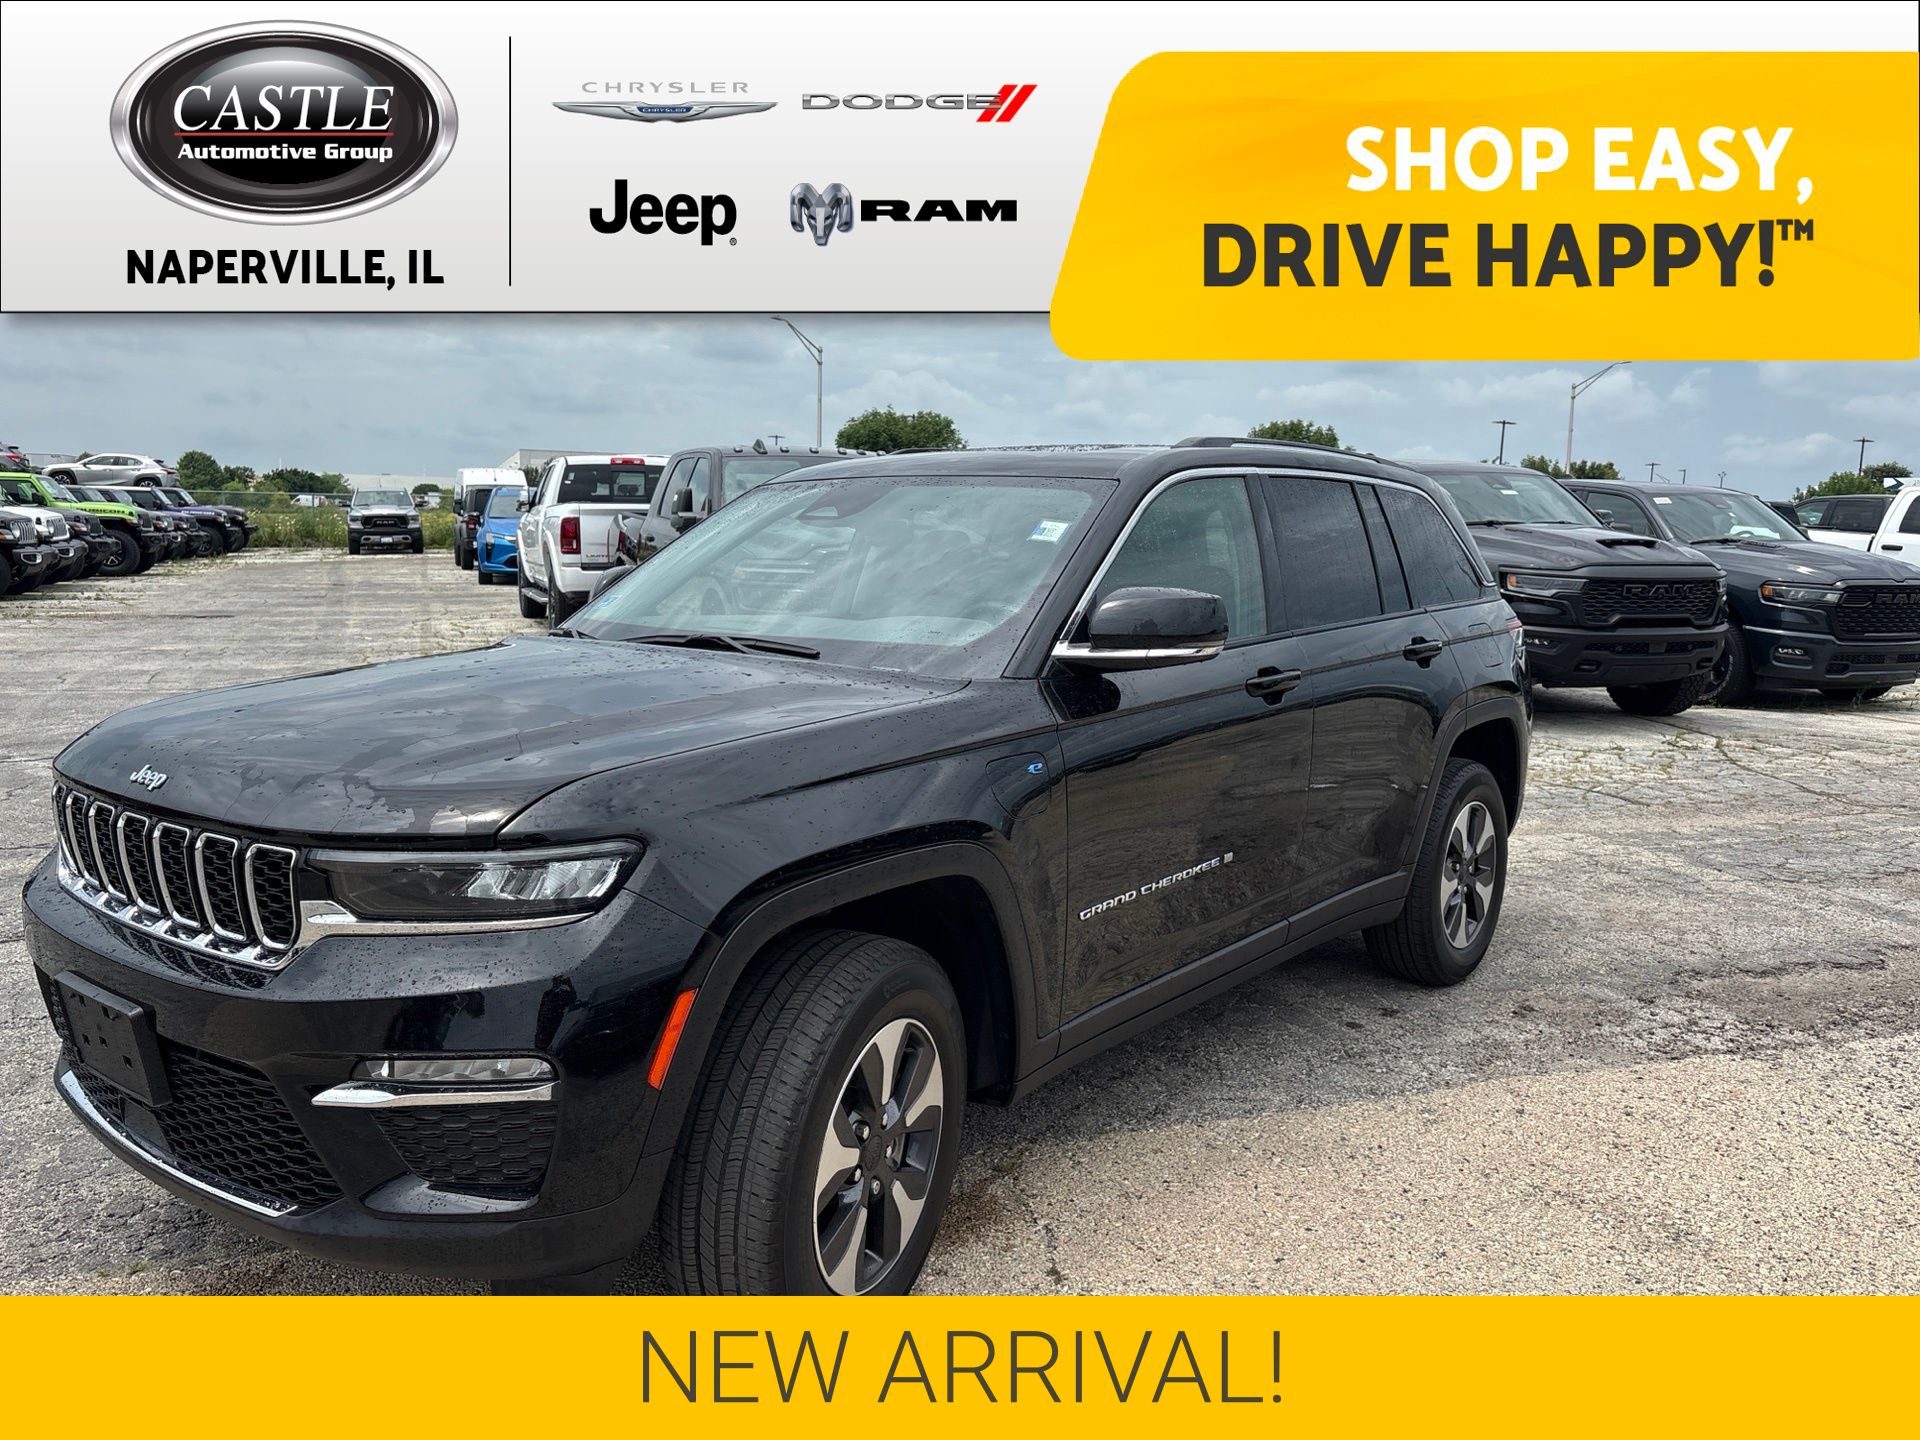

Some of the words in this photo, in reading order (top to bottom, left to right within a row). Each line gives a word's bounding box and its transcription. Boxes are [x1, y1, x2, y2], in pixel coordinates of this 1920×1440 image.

[1622, 583, 1695, 597] RAM
[130, 764, 168, 791] Jeep
[1079, 889, 1137, 921] GRAND
[1139, 856, 1221, 896] CHEROKEE
